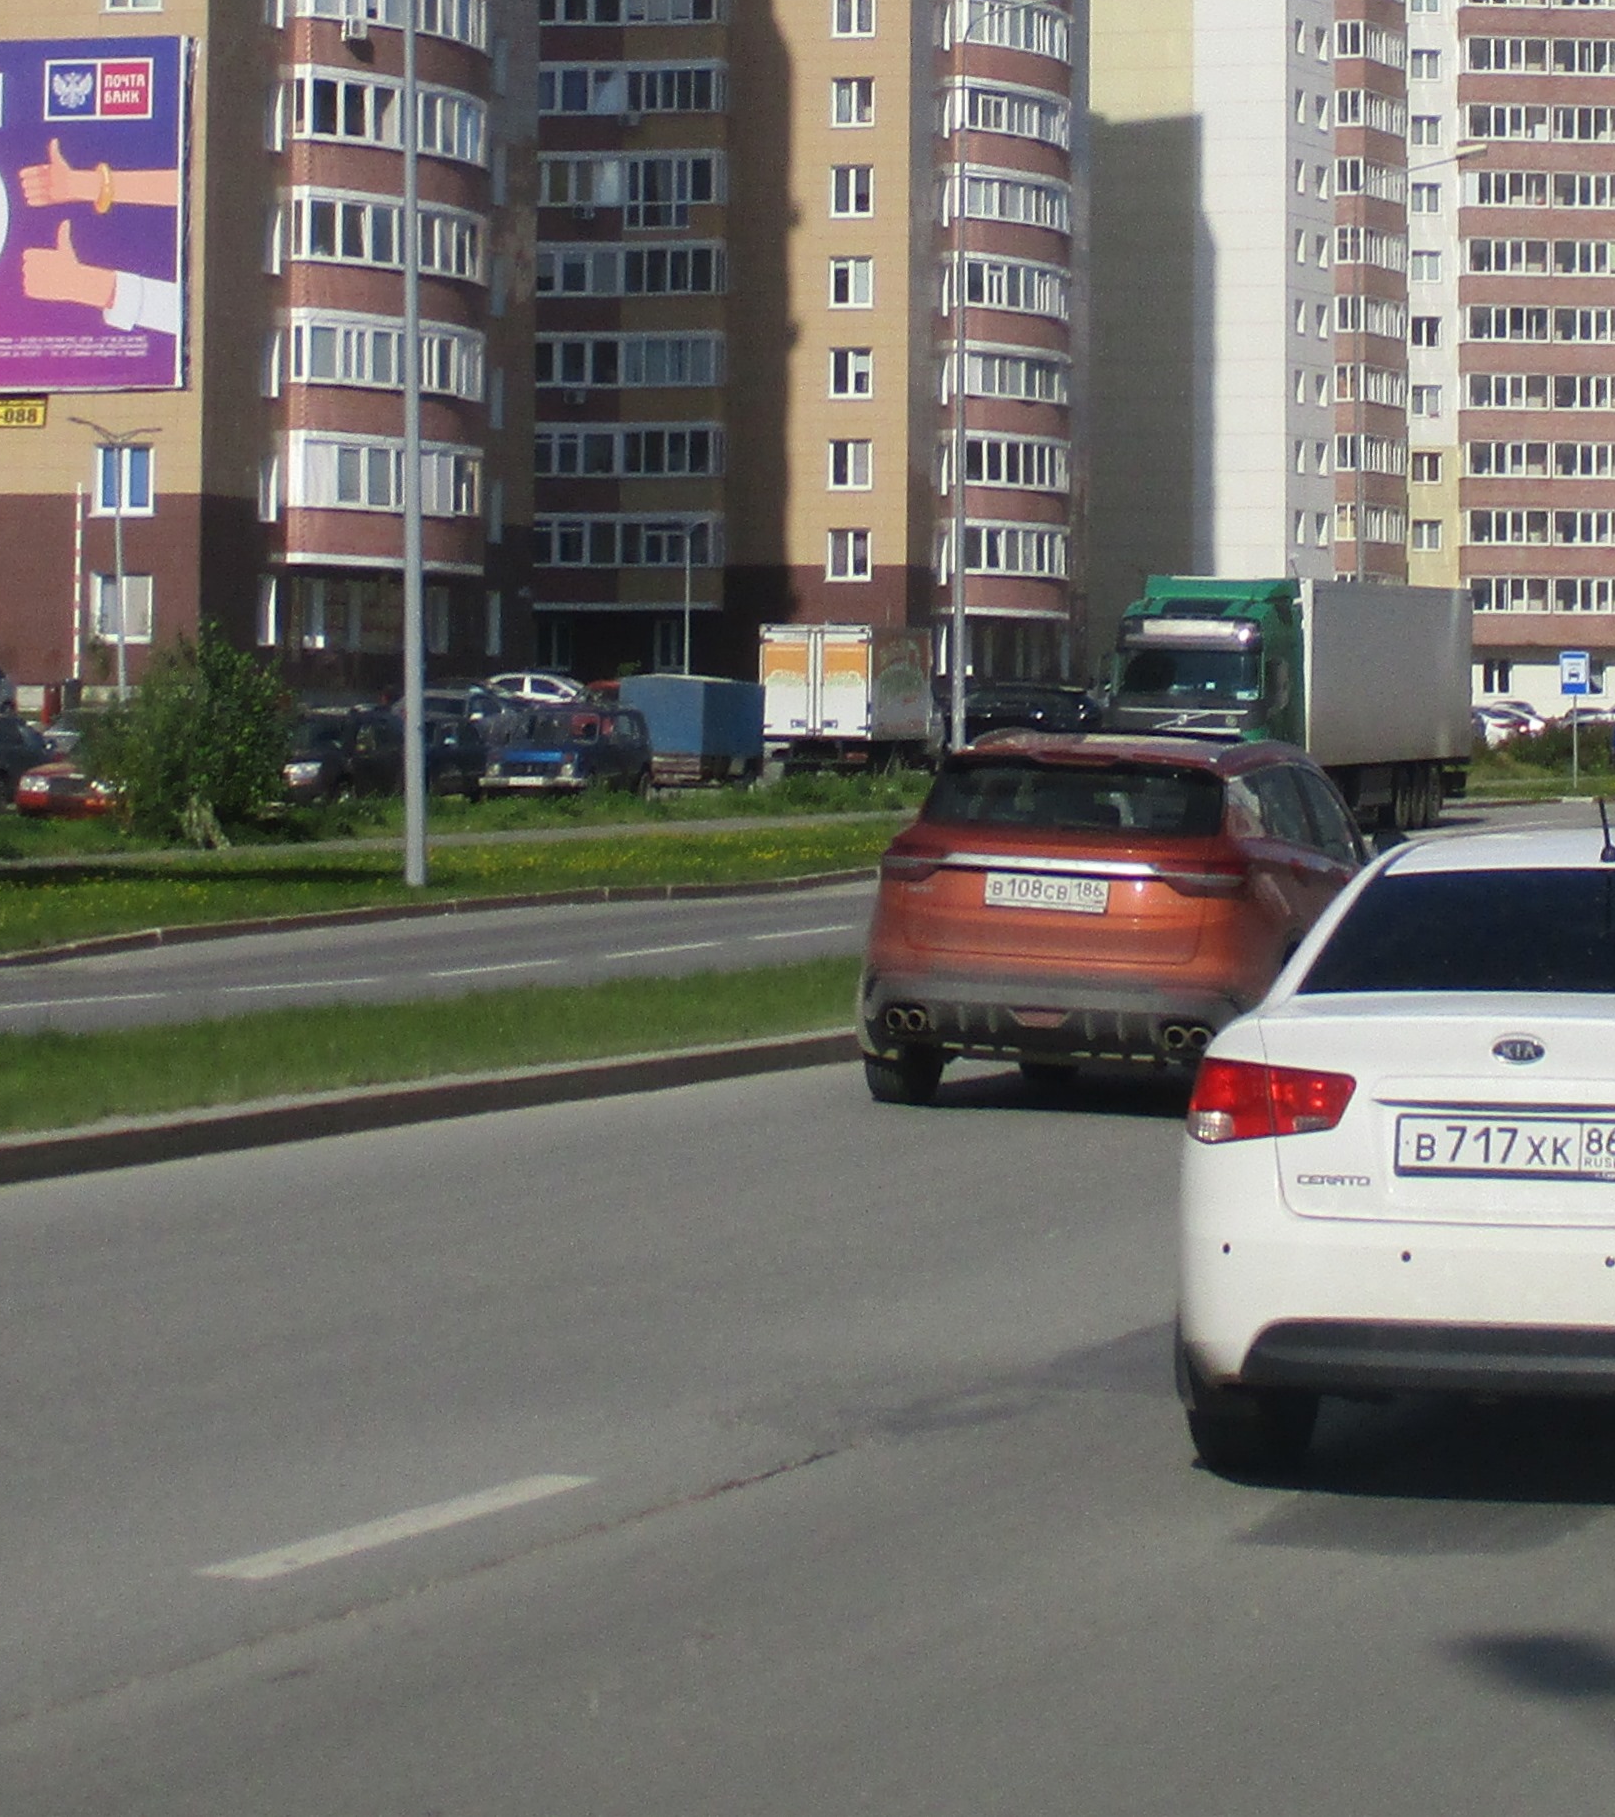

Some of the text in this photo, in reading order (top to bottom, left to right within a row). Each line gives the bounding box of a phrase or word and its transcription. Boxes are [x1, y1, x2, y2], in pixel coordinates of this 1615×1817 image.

[104, 73, 146, 88] ПОЧТА
[104, 90, 140, 104] БАНК
[1075, 882, 1103, 897] 186
[1501, 1043, 1537, 1059] KIA
[1584, 1157, 1615, 1168] RUS
